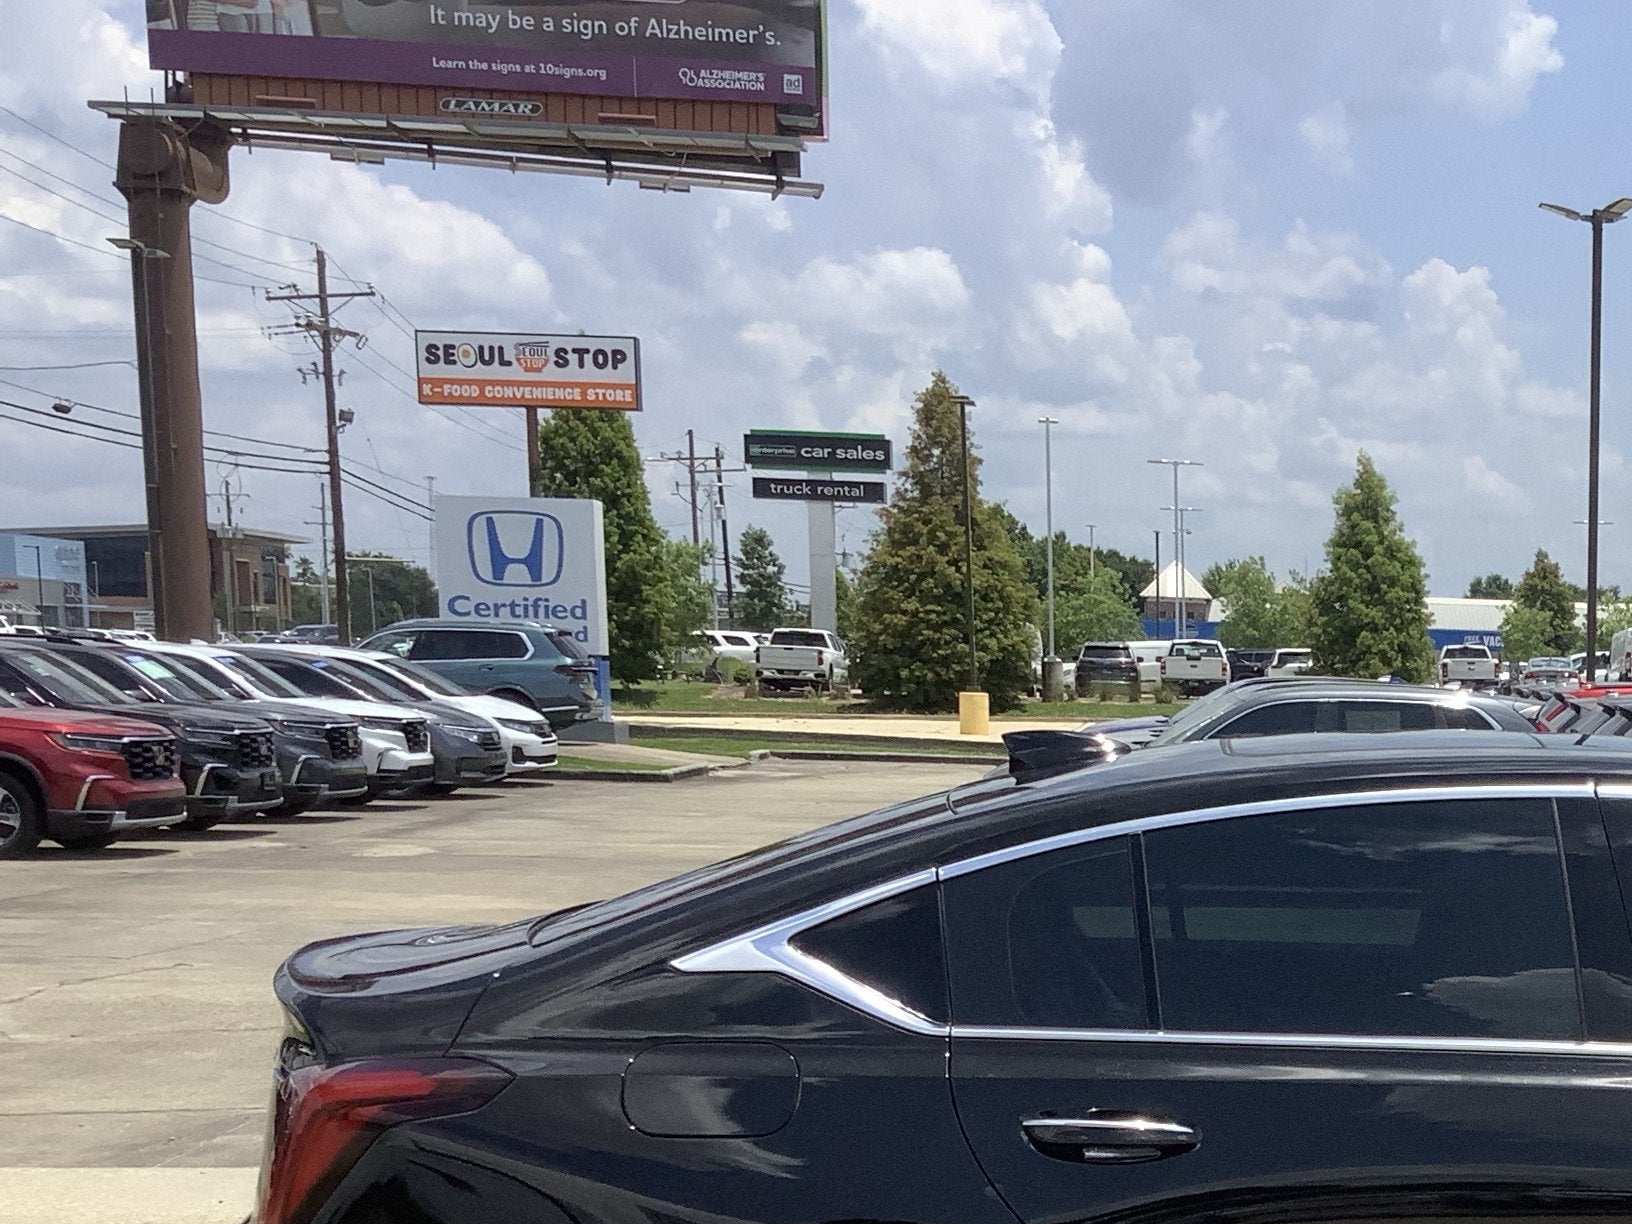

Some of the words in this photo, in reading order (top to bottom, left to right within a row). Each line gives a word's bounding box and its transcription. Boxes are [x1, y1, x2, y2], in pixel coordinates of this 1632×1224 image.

[429, 4, 447, 25] It
[453, 10, 500, 33] may
[508, 9, 535, 30] be
[542, 18, 555, 32] a
[561, 12, 607, 40] sign
[614, 16, 640, 37] of
[645, 17, 782, 46] Alzheimer's.
[432, 57, 466, 70] Learn
[468, 59, 489, 71] the
[491, 60, 521, 75] signs
[524, 63, 537, 73] at
[539, 63, 607, 81] 10signs.org
[699, 69, 765, 82] ALZHEIMER'S
[697, 78, 765, 91] ASSOCIATION
[785, 76, 801, 88] ad
[448, 100, 534, 114] LAMAR
[425, 342, 513, 369] SEOUL
[553, 347, 628, 370] STOP
[520, 358, 546, 369] STOP
[422, 383, 480, 397] K-FOOD
[484, 385, 582, 400] CONVENIENCE
[586, 388, 633, 402] STORE
[800, 447, 832, 458] car
[835, 445, 886, 461] sales
[769, 482, 812, 495] truck
[817, 484, 864, 497] rental
[447, 594, 588, 621] Certified
